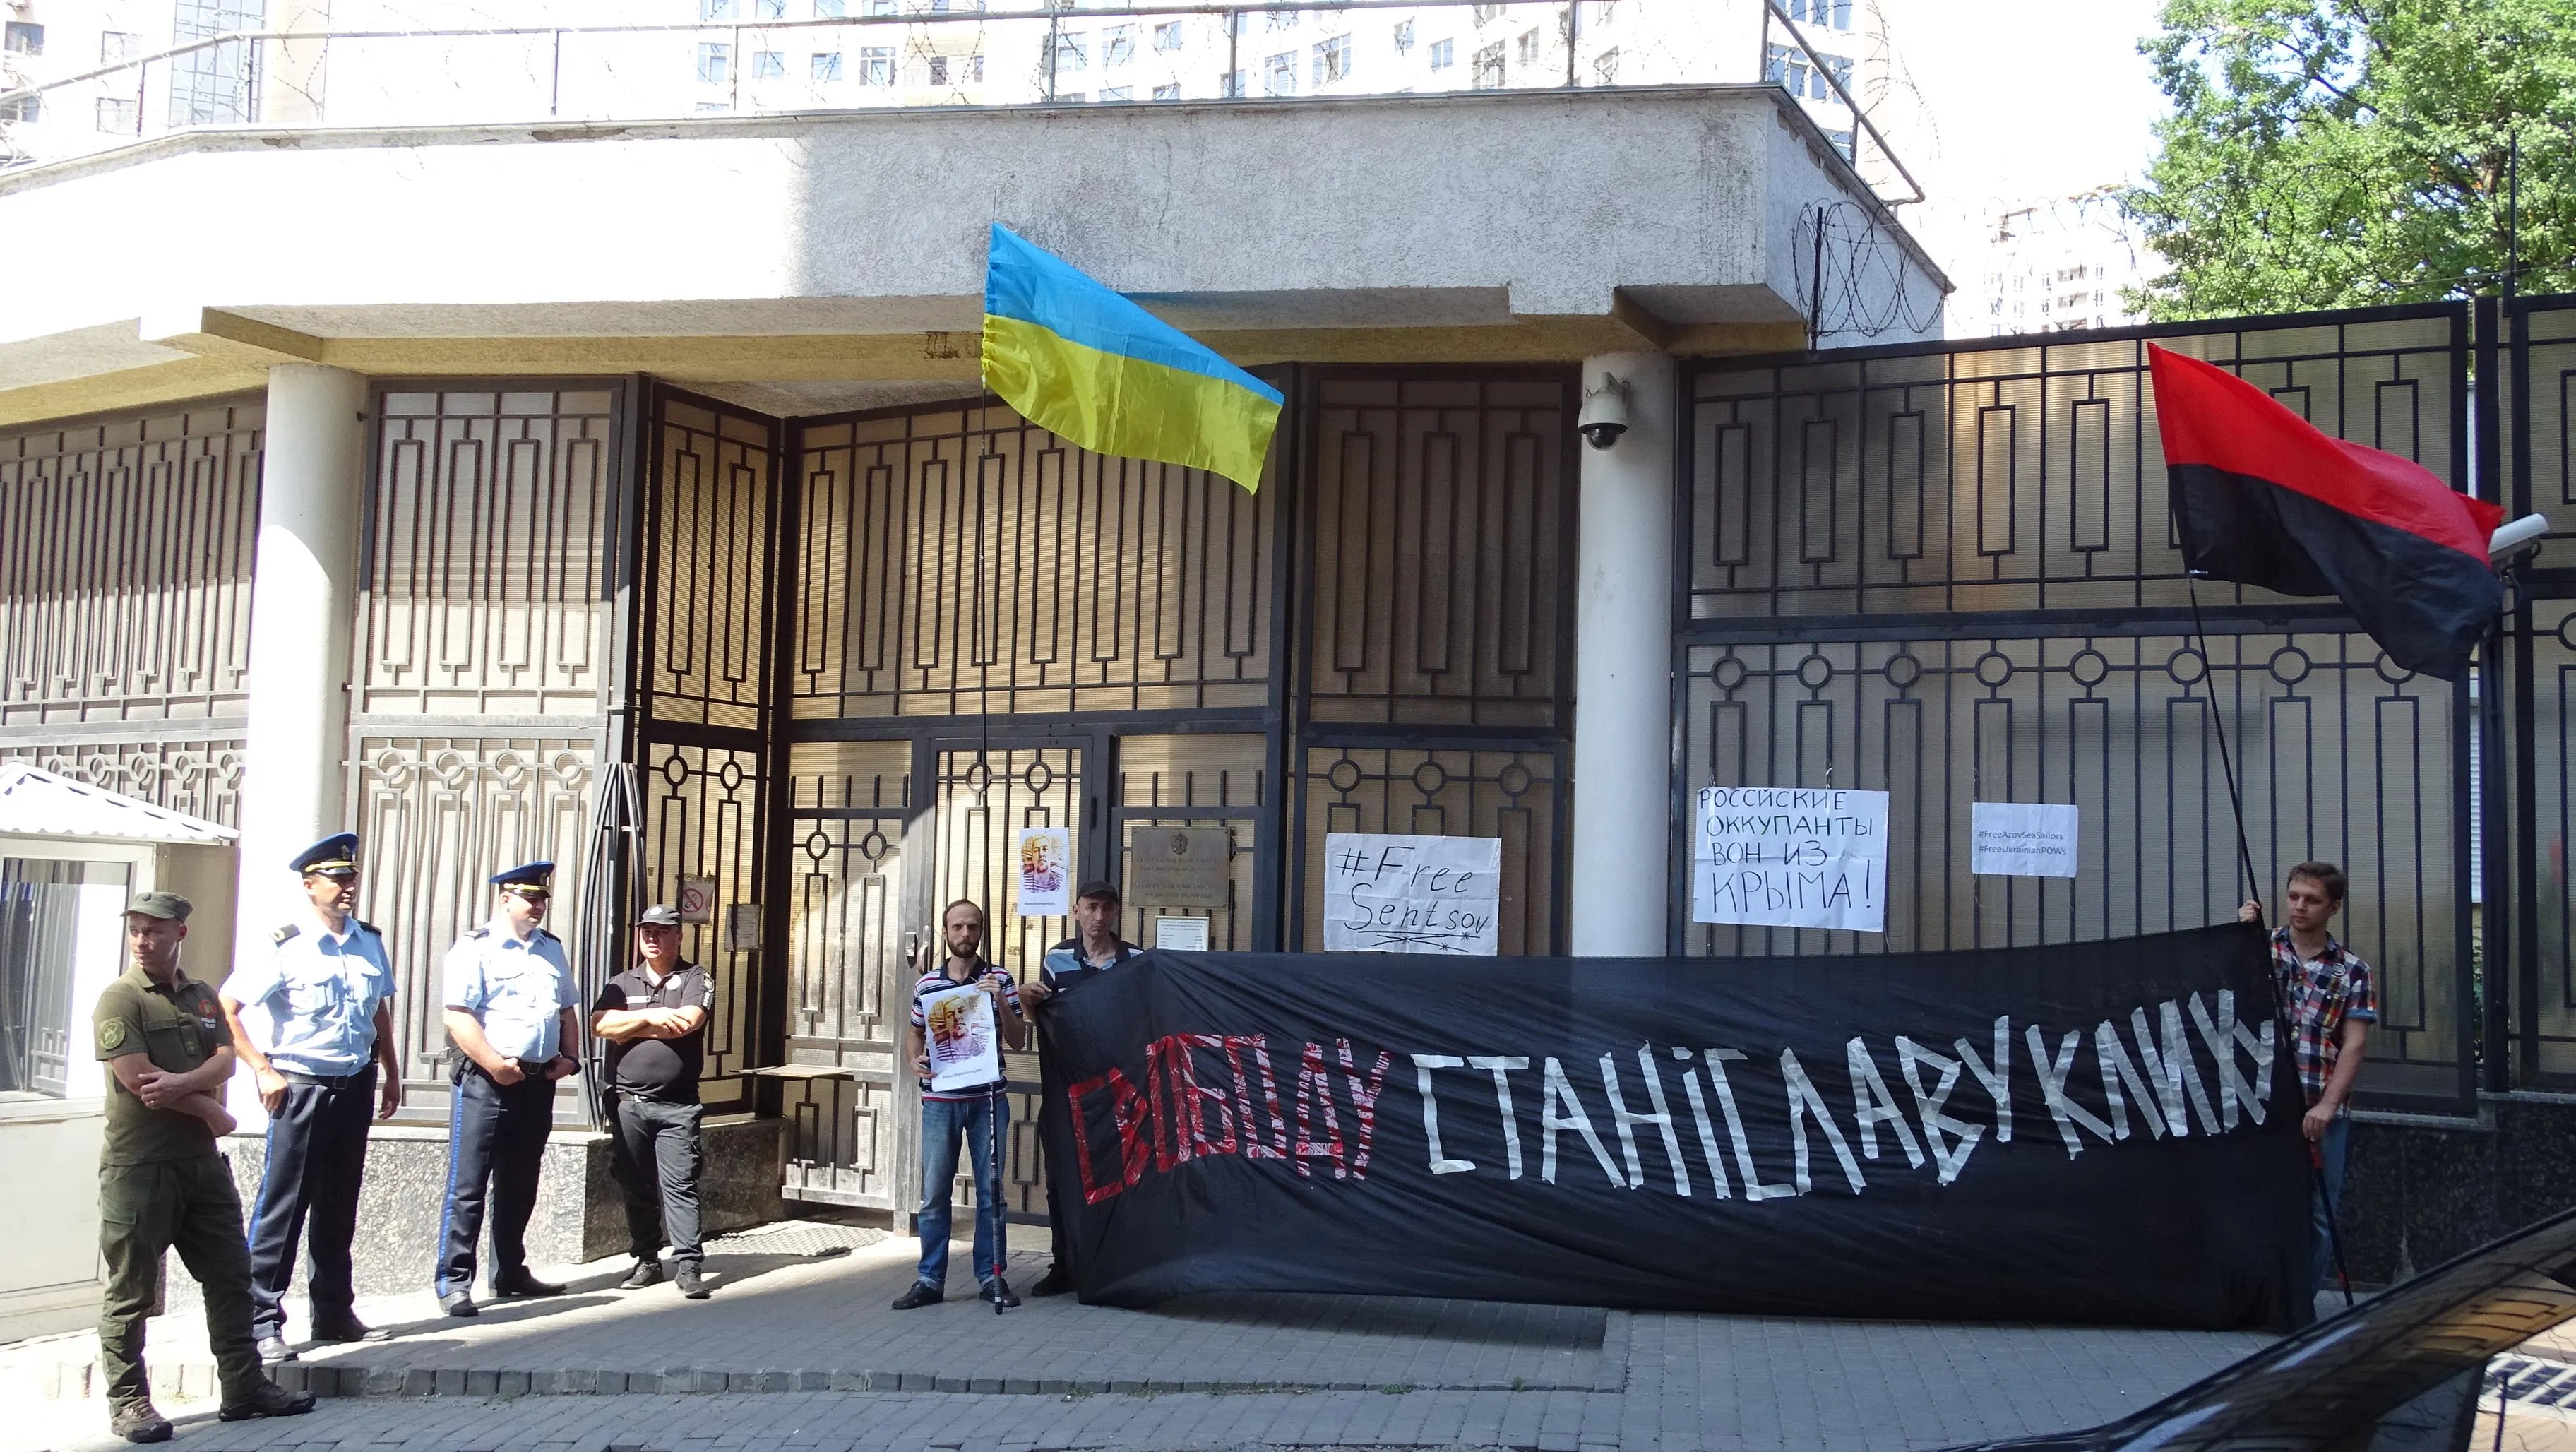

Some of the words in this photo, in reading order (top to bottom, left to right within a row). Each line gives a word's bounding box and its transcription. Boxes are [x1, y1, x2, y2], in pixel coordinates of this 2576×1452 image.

[1700, 789, 1847, 810] РОССЙСКИЕ
[1706, 815, 1872, 836] ОККУПАНТЫ
[1979, 831, 2064, 840] #FreeAzovSeaSailors
[1712, 842, 1761, 867] ВОН
[1784, 840, 1827, 867] ИЗ
[1979, 845, 2067, 855] #FreeUkrainianPOWs
[1335, 846, 1473, 893] #Free
[1712, 859, 1871, 913] КРЫМА!
[1344, 883, 1489, 934] Sentsov
[1068, 1033, 1393, 1205] СВОБОДУ
[2025, 989, 2274, 1160] КЛИХУ
